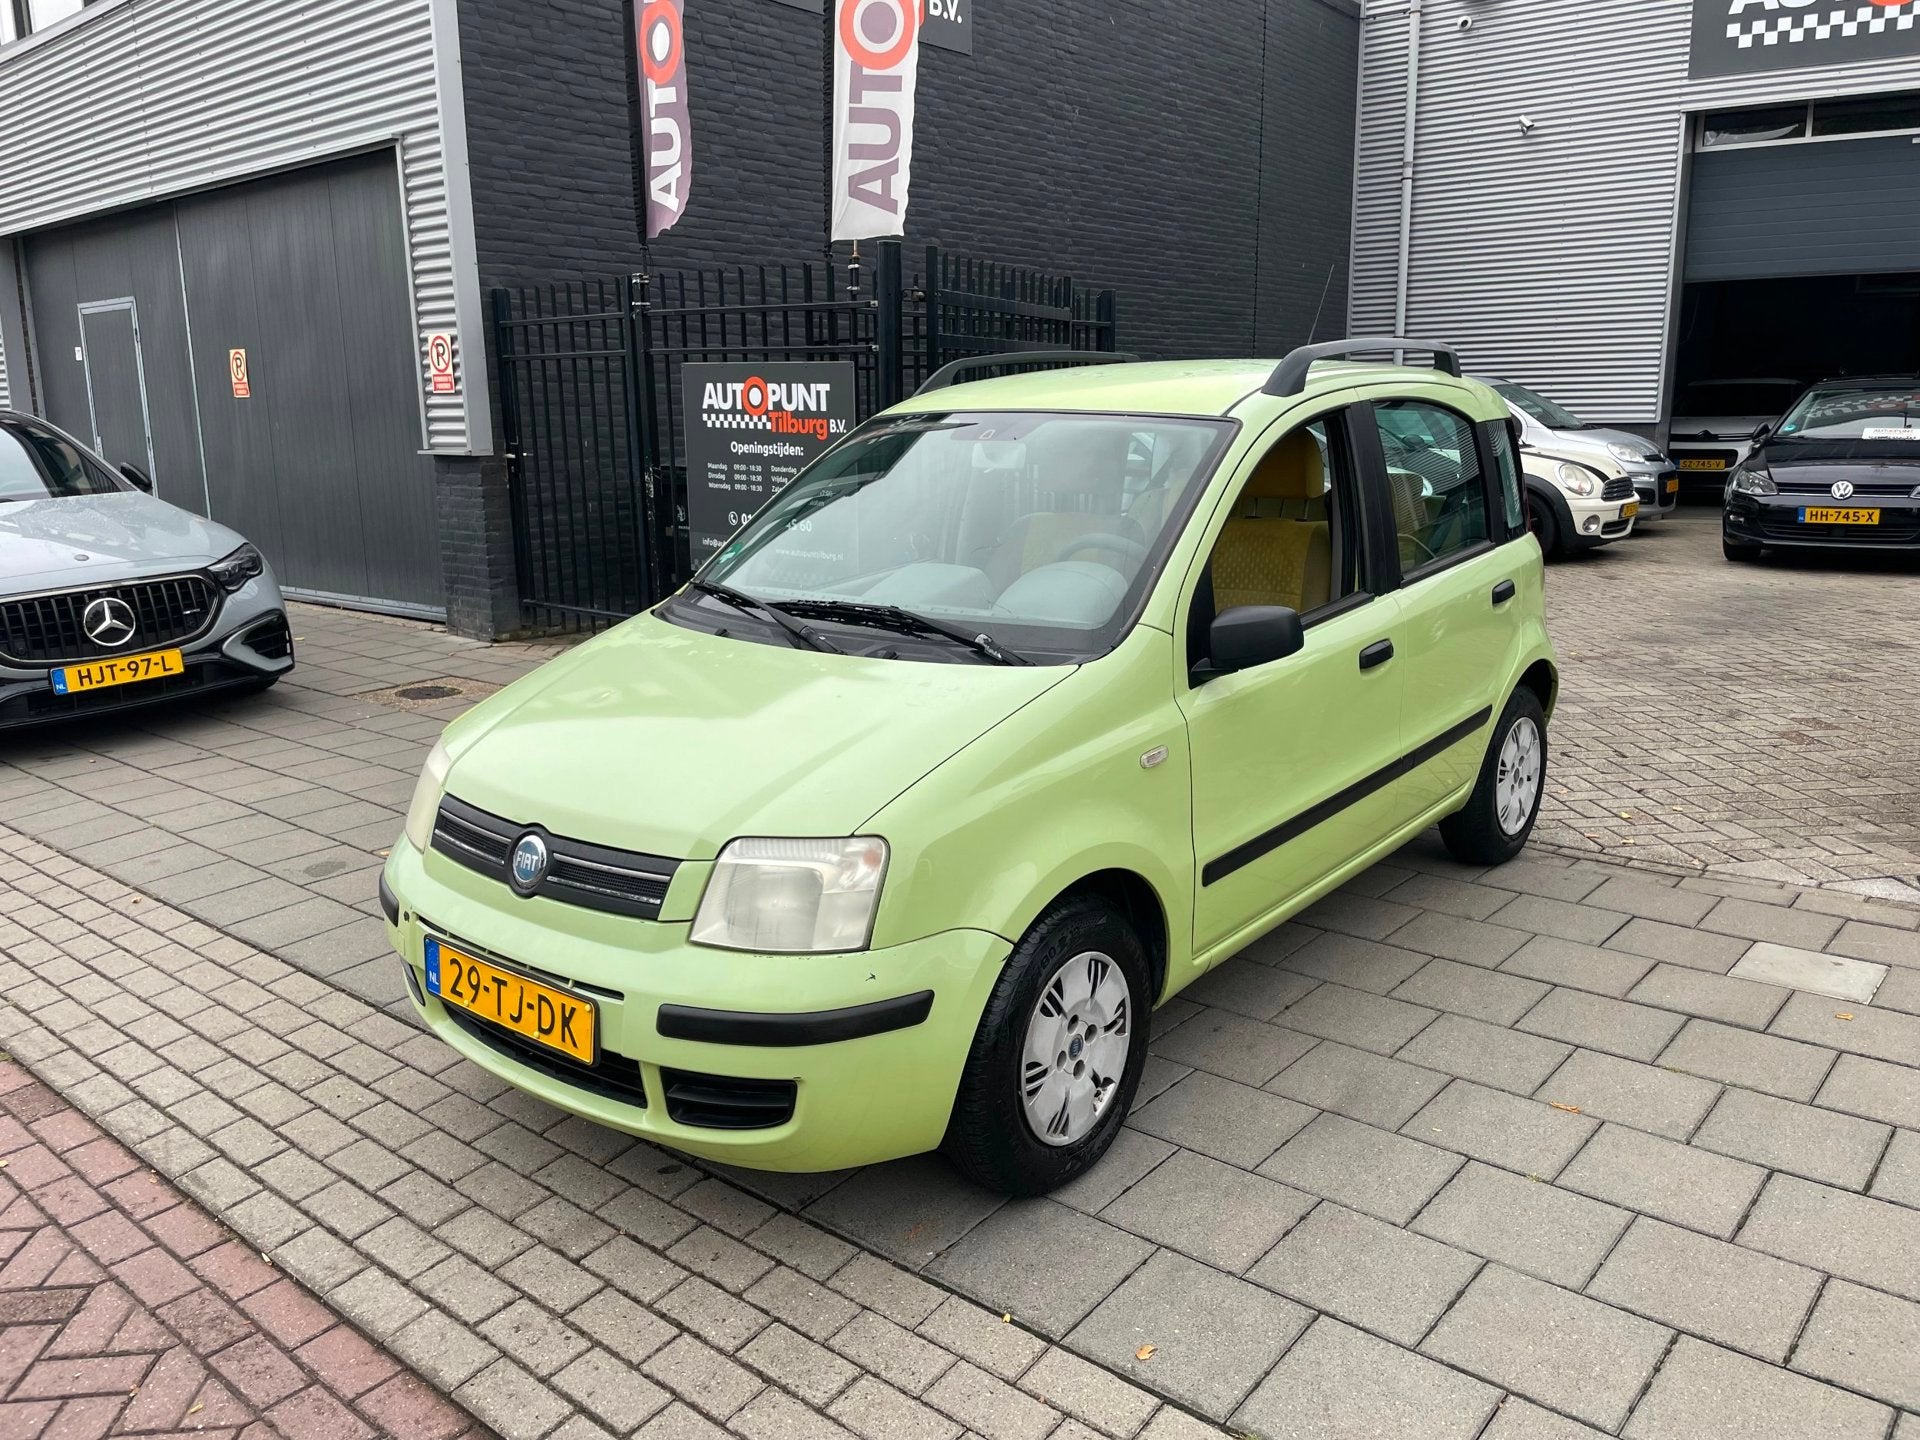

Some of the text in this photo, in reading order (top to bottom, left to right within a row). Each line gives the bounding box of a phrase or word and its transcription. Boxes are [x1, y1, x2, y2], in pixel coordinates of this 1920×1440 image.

[702, 376, 831, 416] AUTOPUNT
[768, 411, 847, 440] Tilburg B.V.
[730, 441, 804, 457] Openingstijden:
[707, 462, 728, 471] Maandag
[770, 465, 797, 475] Donderdag
[707, 472, 726, 480] Dinsdag
[708, 482, 731, 491] Woensdag
[1809, 510, 1875, 522] HH-745-X
[77, 654, 174, 688] HJT-97-L
[55, 682, 66, 691] NL
[515, 851, 539, 873] FIAT
[428, 970, 440, 986] NL
[449, 957, 579, 1050] 29-TJ-DK
